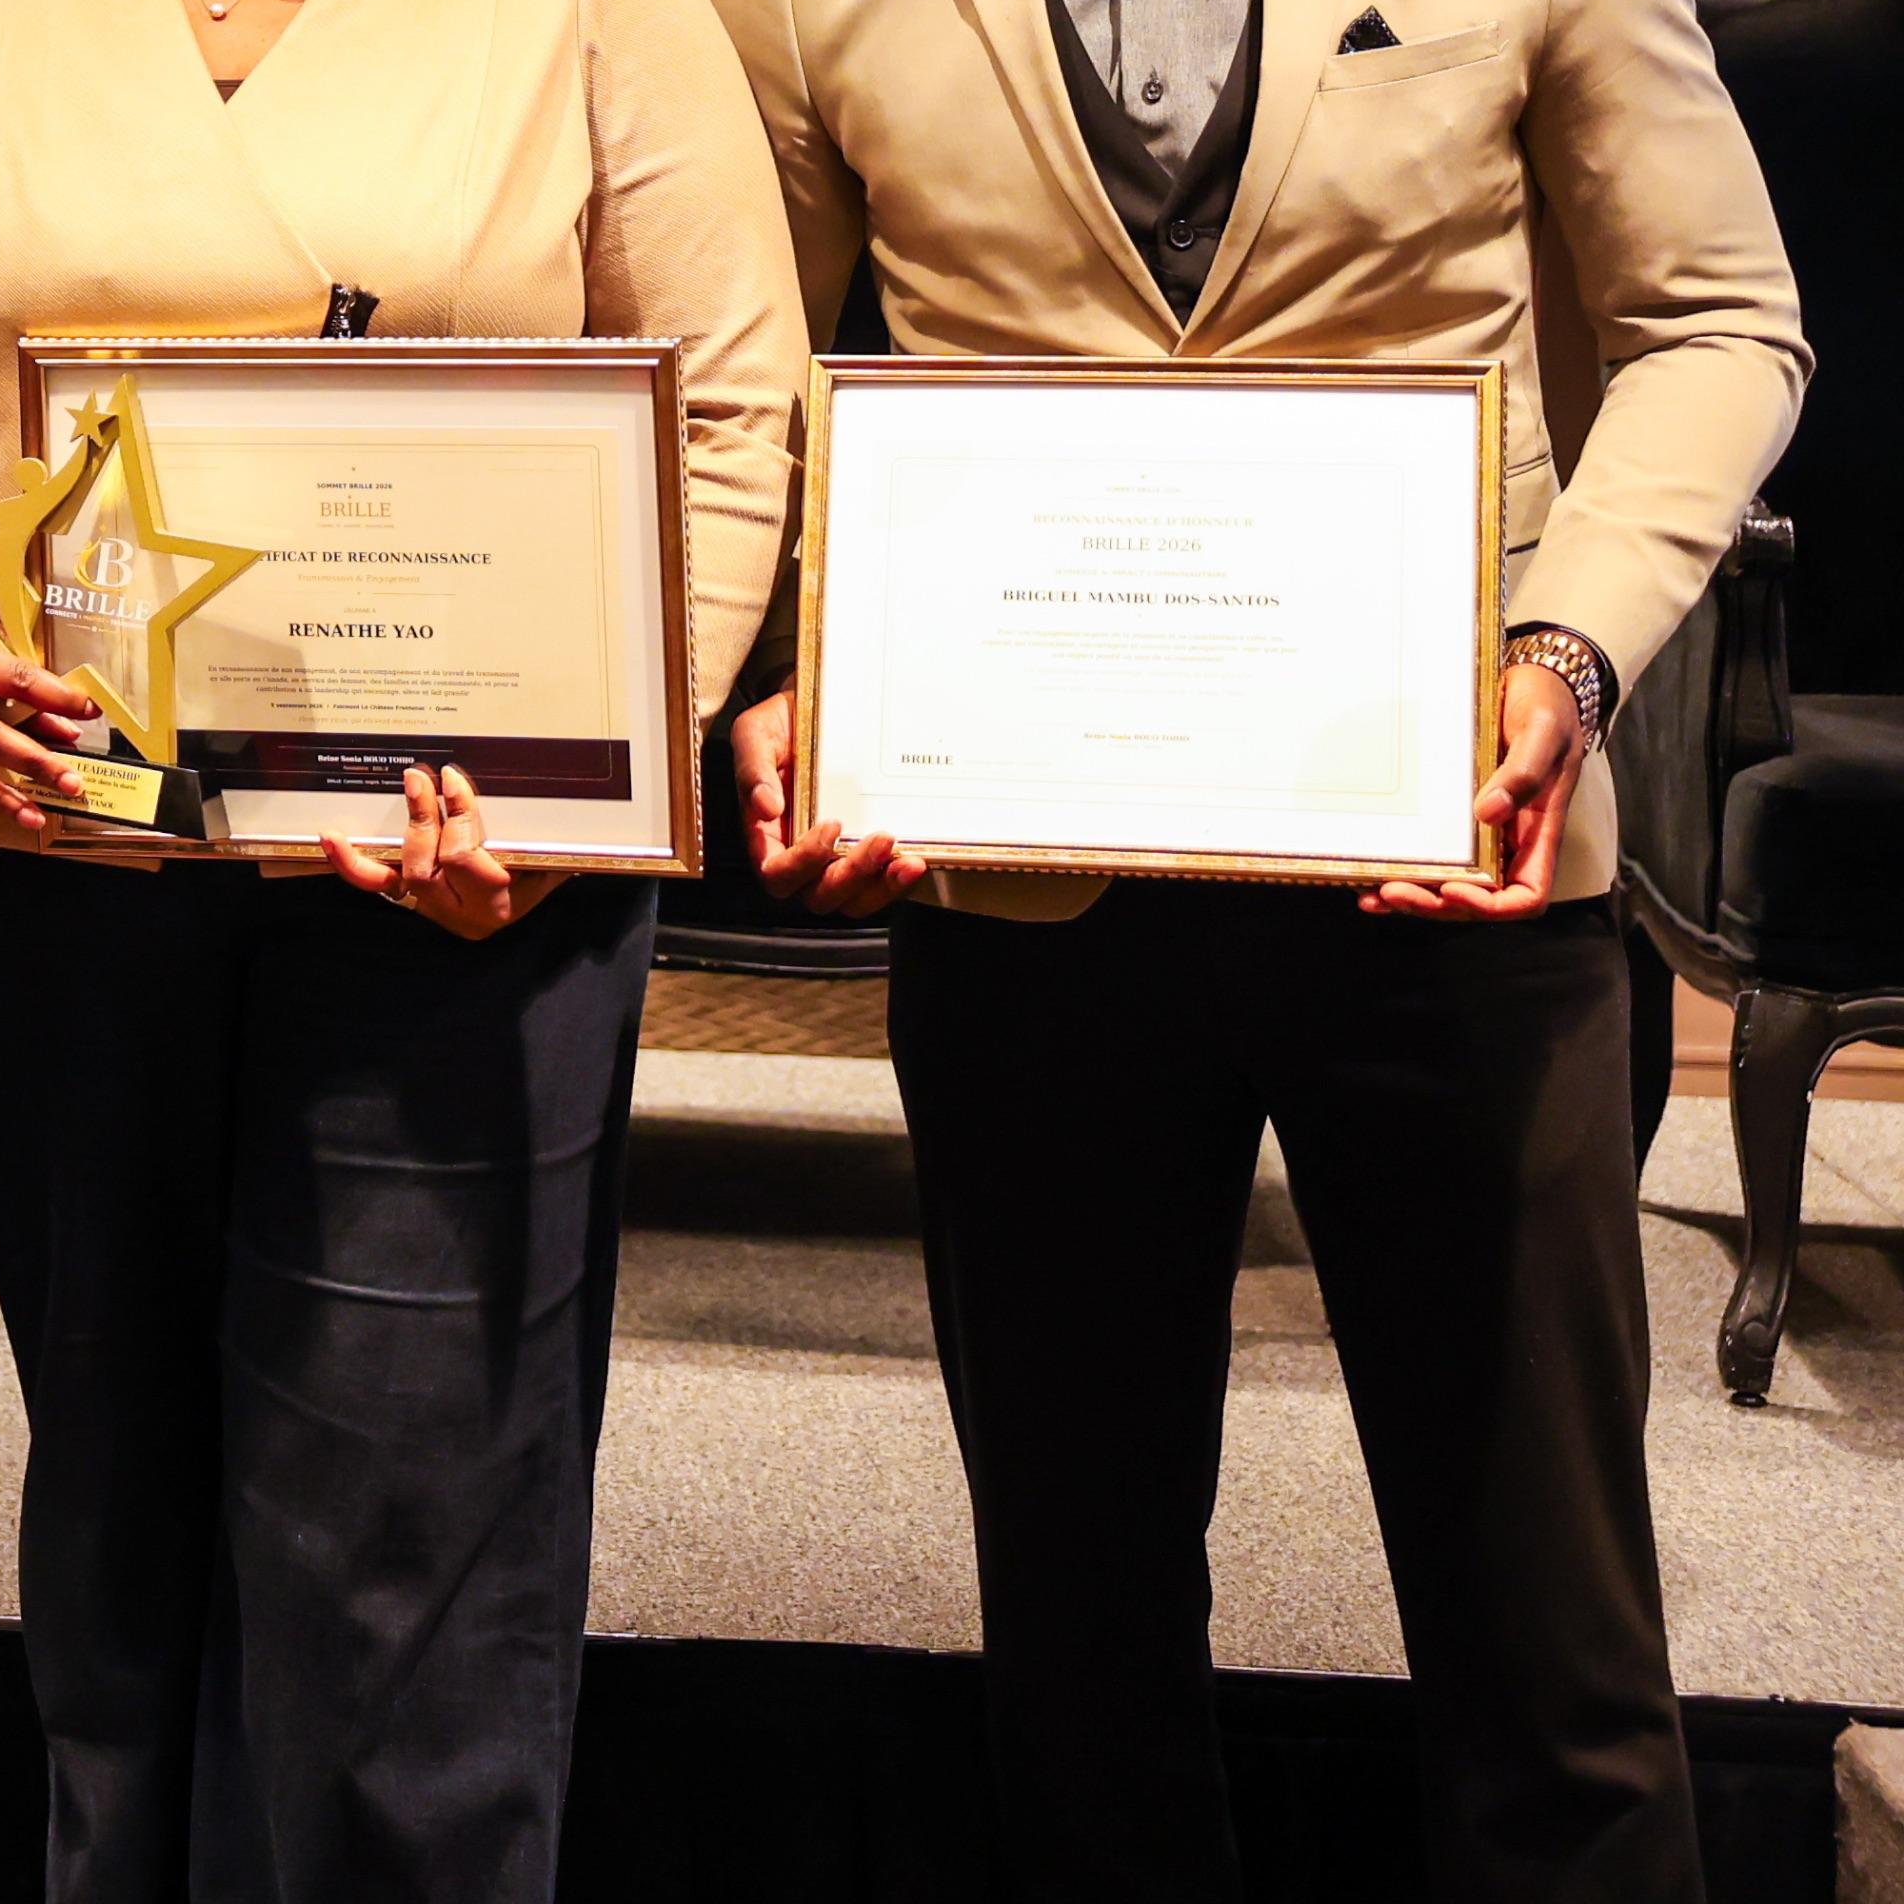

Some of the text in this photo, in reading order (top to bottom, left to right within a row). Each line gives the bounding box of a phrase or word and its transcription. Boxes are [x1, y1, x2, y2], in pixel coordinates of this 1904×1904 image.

[317, 482, 347, 490] SOMMET
[349, 482, 373, 490] BRILLE
[320, 501, 391, 518] BRILLE
[1033, 513, 1160, 527] RECONNAISSANCE
[1082, 536, 1201, 553] BRILLE 2026
[262, 550, 492, 565] IFICAT DE RECONNAISSANCE
[44, 583, 152, 621] BRILLE
[1003, 589, 1280, 607] BRIGUEL MAMBU DOS-SANTOS
[288, 622, 434, 639] RENATHE YAO
[341, 755, 362, 763] Sonia
[901, 753, 954, 765] BRILLE
[77, 762, 141, 782] LEADERSHIP
